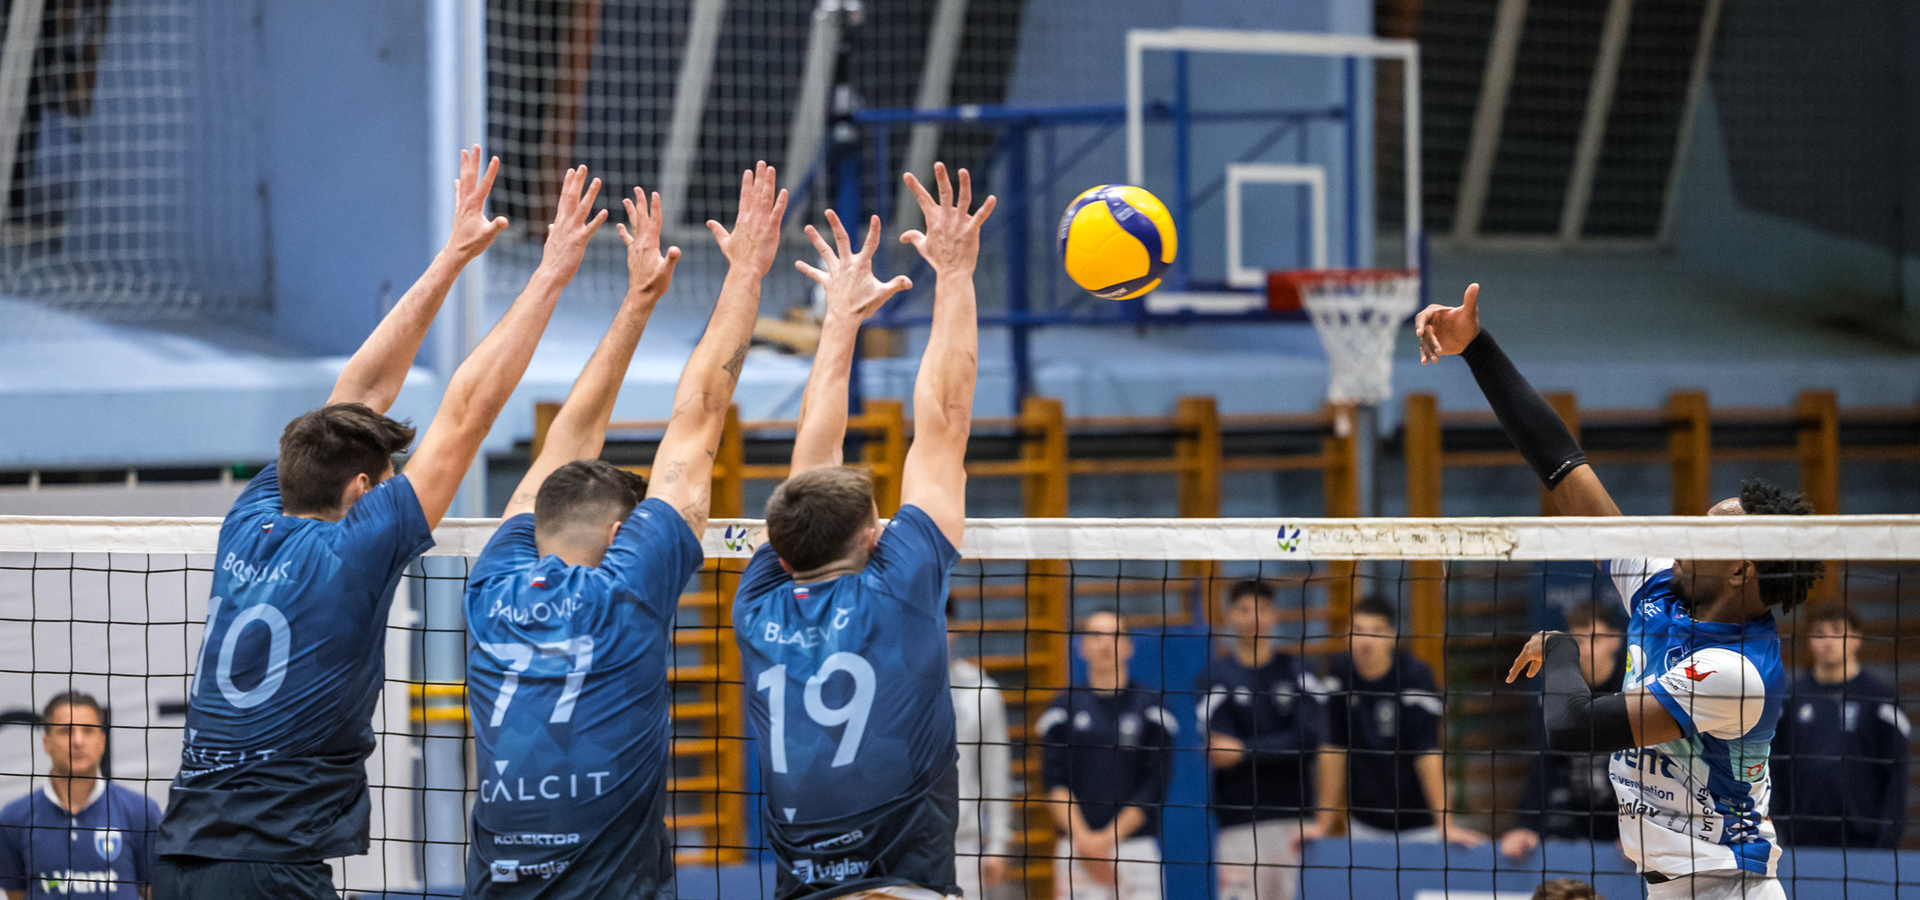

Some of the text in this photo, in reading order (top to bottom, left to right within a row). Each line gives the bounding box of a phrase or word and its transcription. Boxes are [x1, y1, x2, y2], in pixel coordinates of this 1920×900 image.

[191, 595, 292, 709] 10
[479, 634, 594, 727] 77
[757, 651, 877, 774] 19
[480, 771, 611, 803] CALCIT
[494, 833, 580, 845] KOLEKTOR
